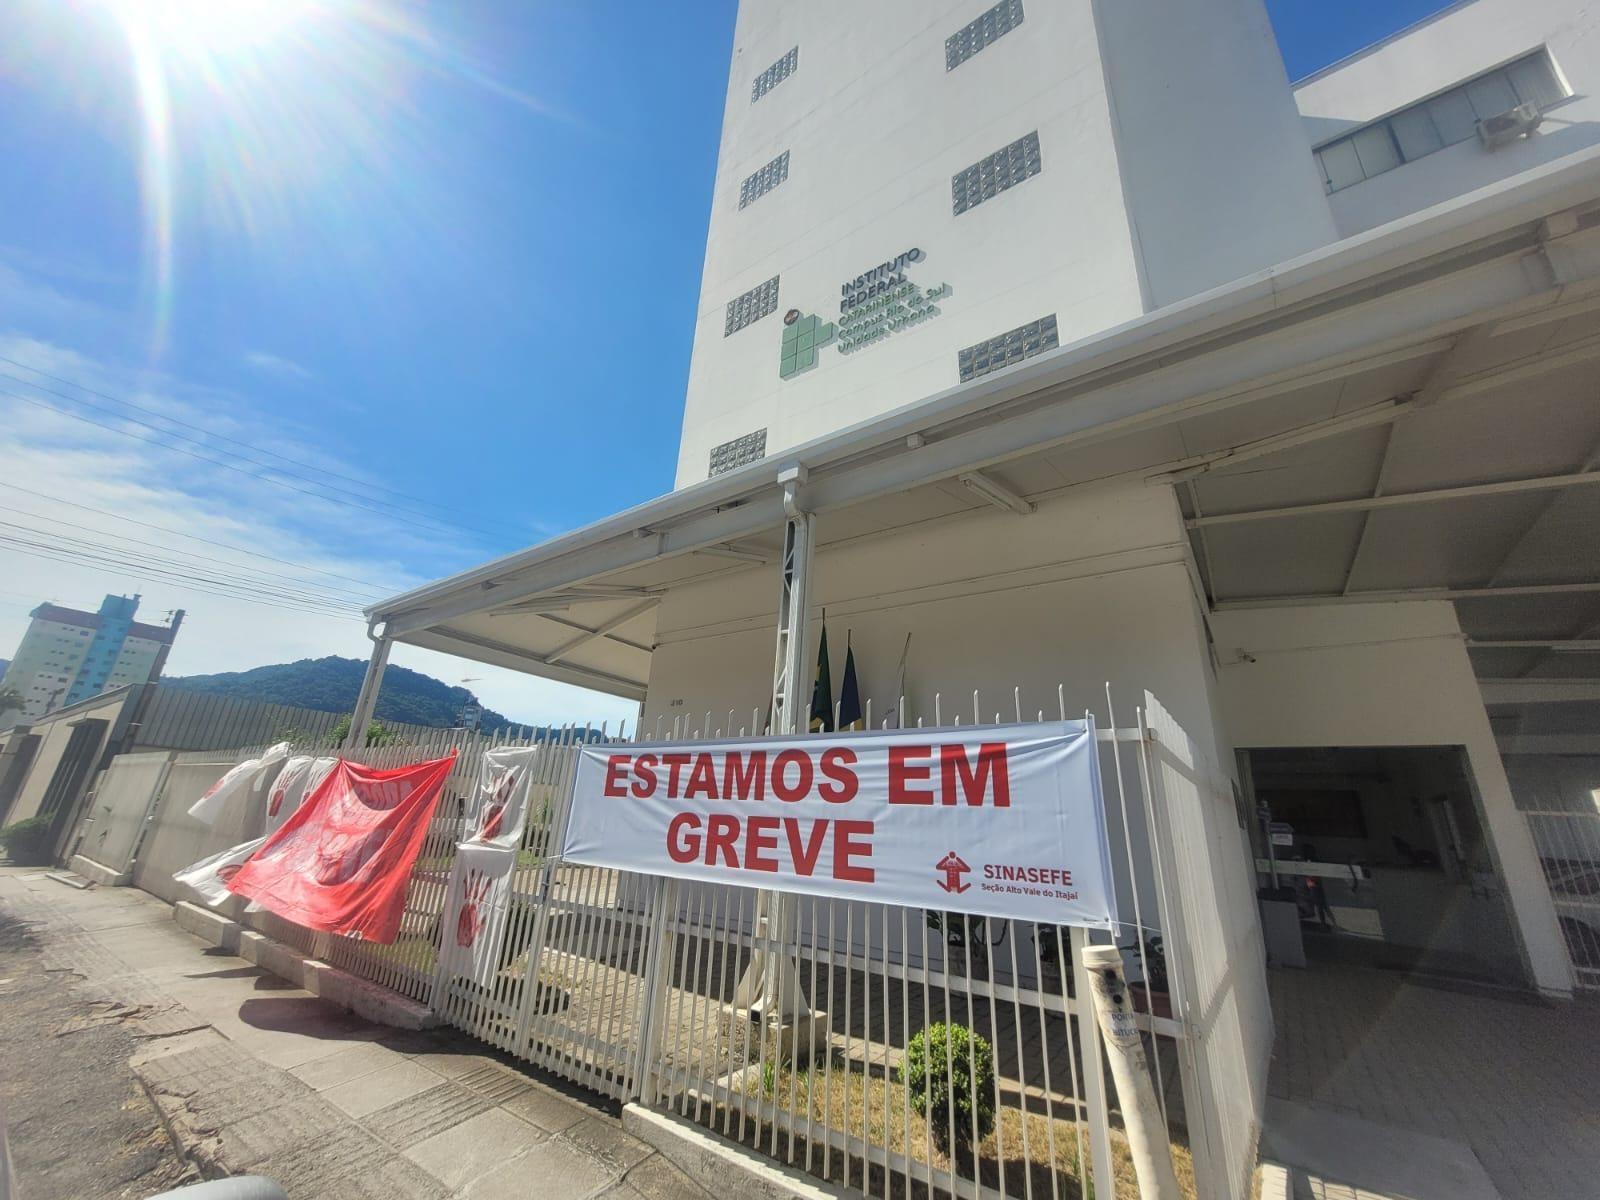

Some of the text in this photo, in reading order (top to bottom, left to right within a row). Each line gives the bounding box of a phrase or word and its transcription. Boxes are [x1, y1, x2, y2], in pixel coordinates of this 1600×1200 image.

[840, 272, 907, 313] FEDERAL
[842, 247, 920, 296] INSTITUTO
[838, 283, 915, 326] CATARINENSE
[838, 313, 886, 340] Campus
[907, 293, 924, 308] do
[926, 282, 945, 300] Sul
[603, 742, 1012, 807] ESTAMOS EM
[666, 811, 876, 883] GREVE
[982, 883, 1005, 893] Seção
[1006, 886, 1022, 895] Alto
[1023, 888, 1041, 897] Vale
[1043, 889, 1054, 898] do
[984, 865, 1072, 886] SINASEFE
